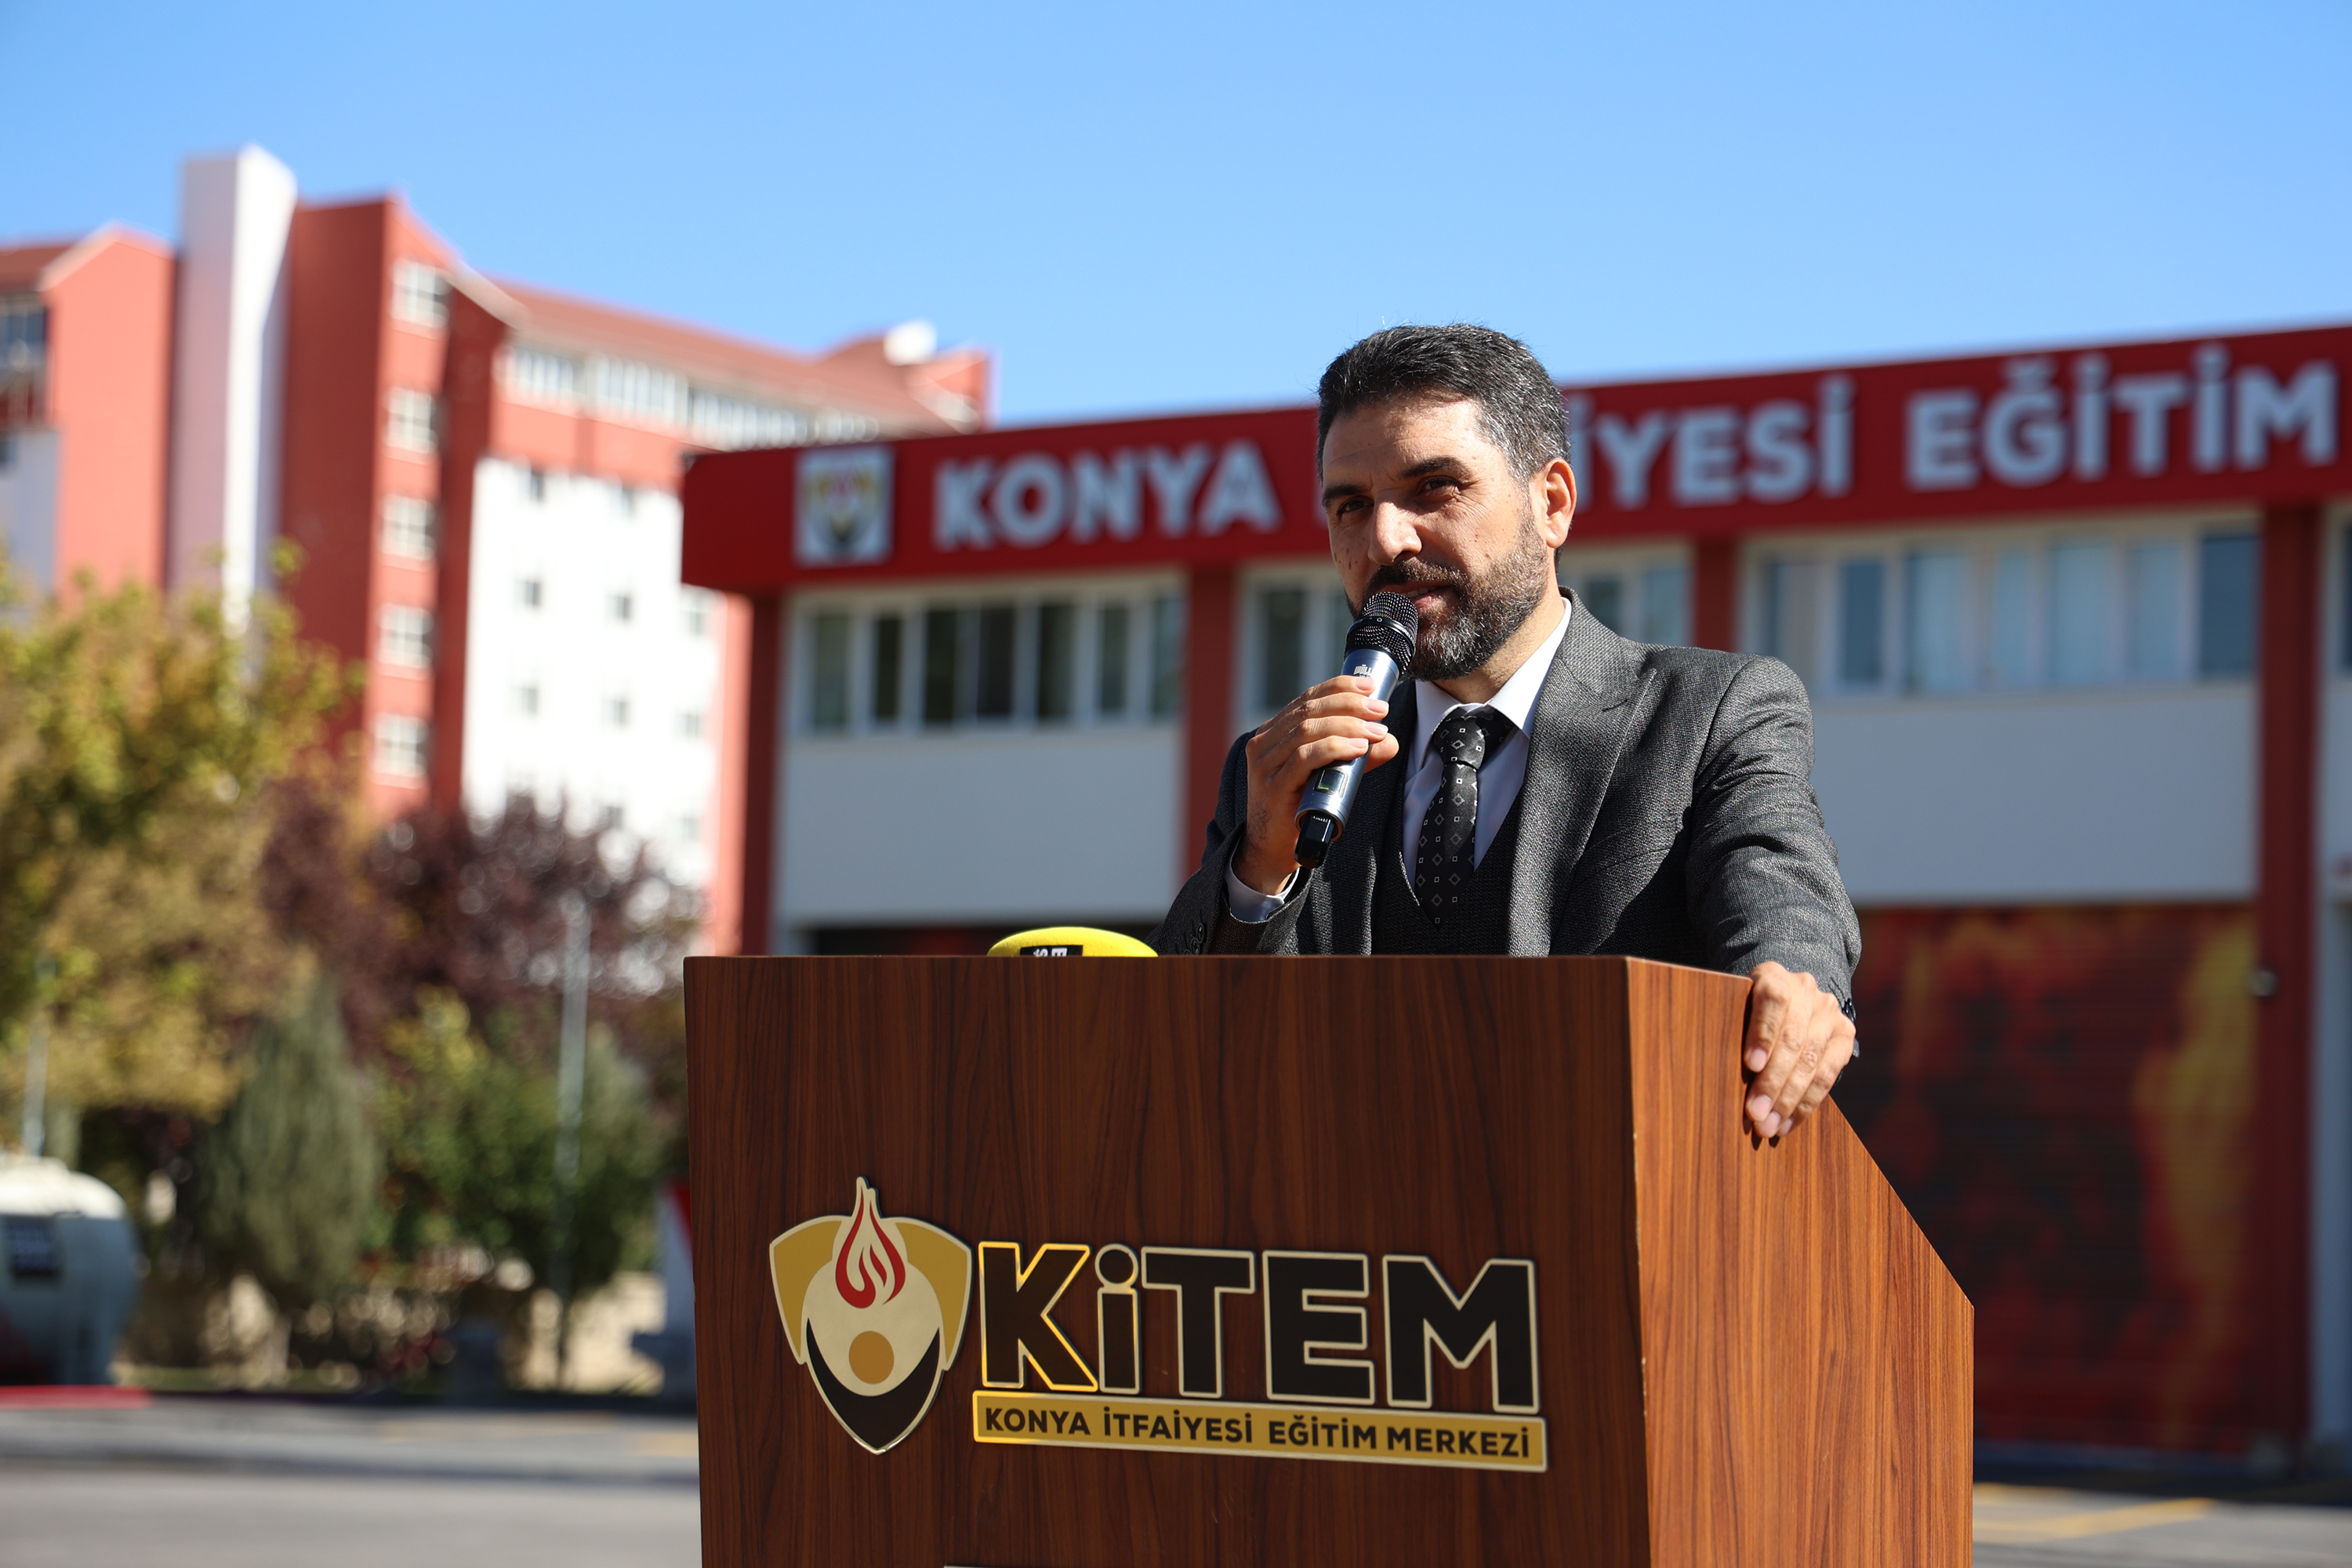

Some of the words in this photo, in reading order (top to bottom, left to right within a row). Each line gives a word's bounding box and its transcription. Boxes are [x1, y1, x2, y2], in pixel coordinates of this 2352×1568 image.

[935, 441, 1281, 548] KONYA
[1569, 375, 1854, 511] İYESİ
[1905, 343, 2339, 491] EĞİTİM
[985, 1406, 1091, 1436] KONYA
[1103, 1406, 1253, 1443] İTFAİYESİ
[1268, 1414, 1377, 1450] EĞİTİM
[1387, 1426, 1530, 1458] MERKEZİ
